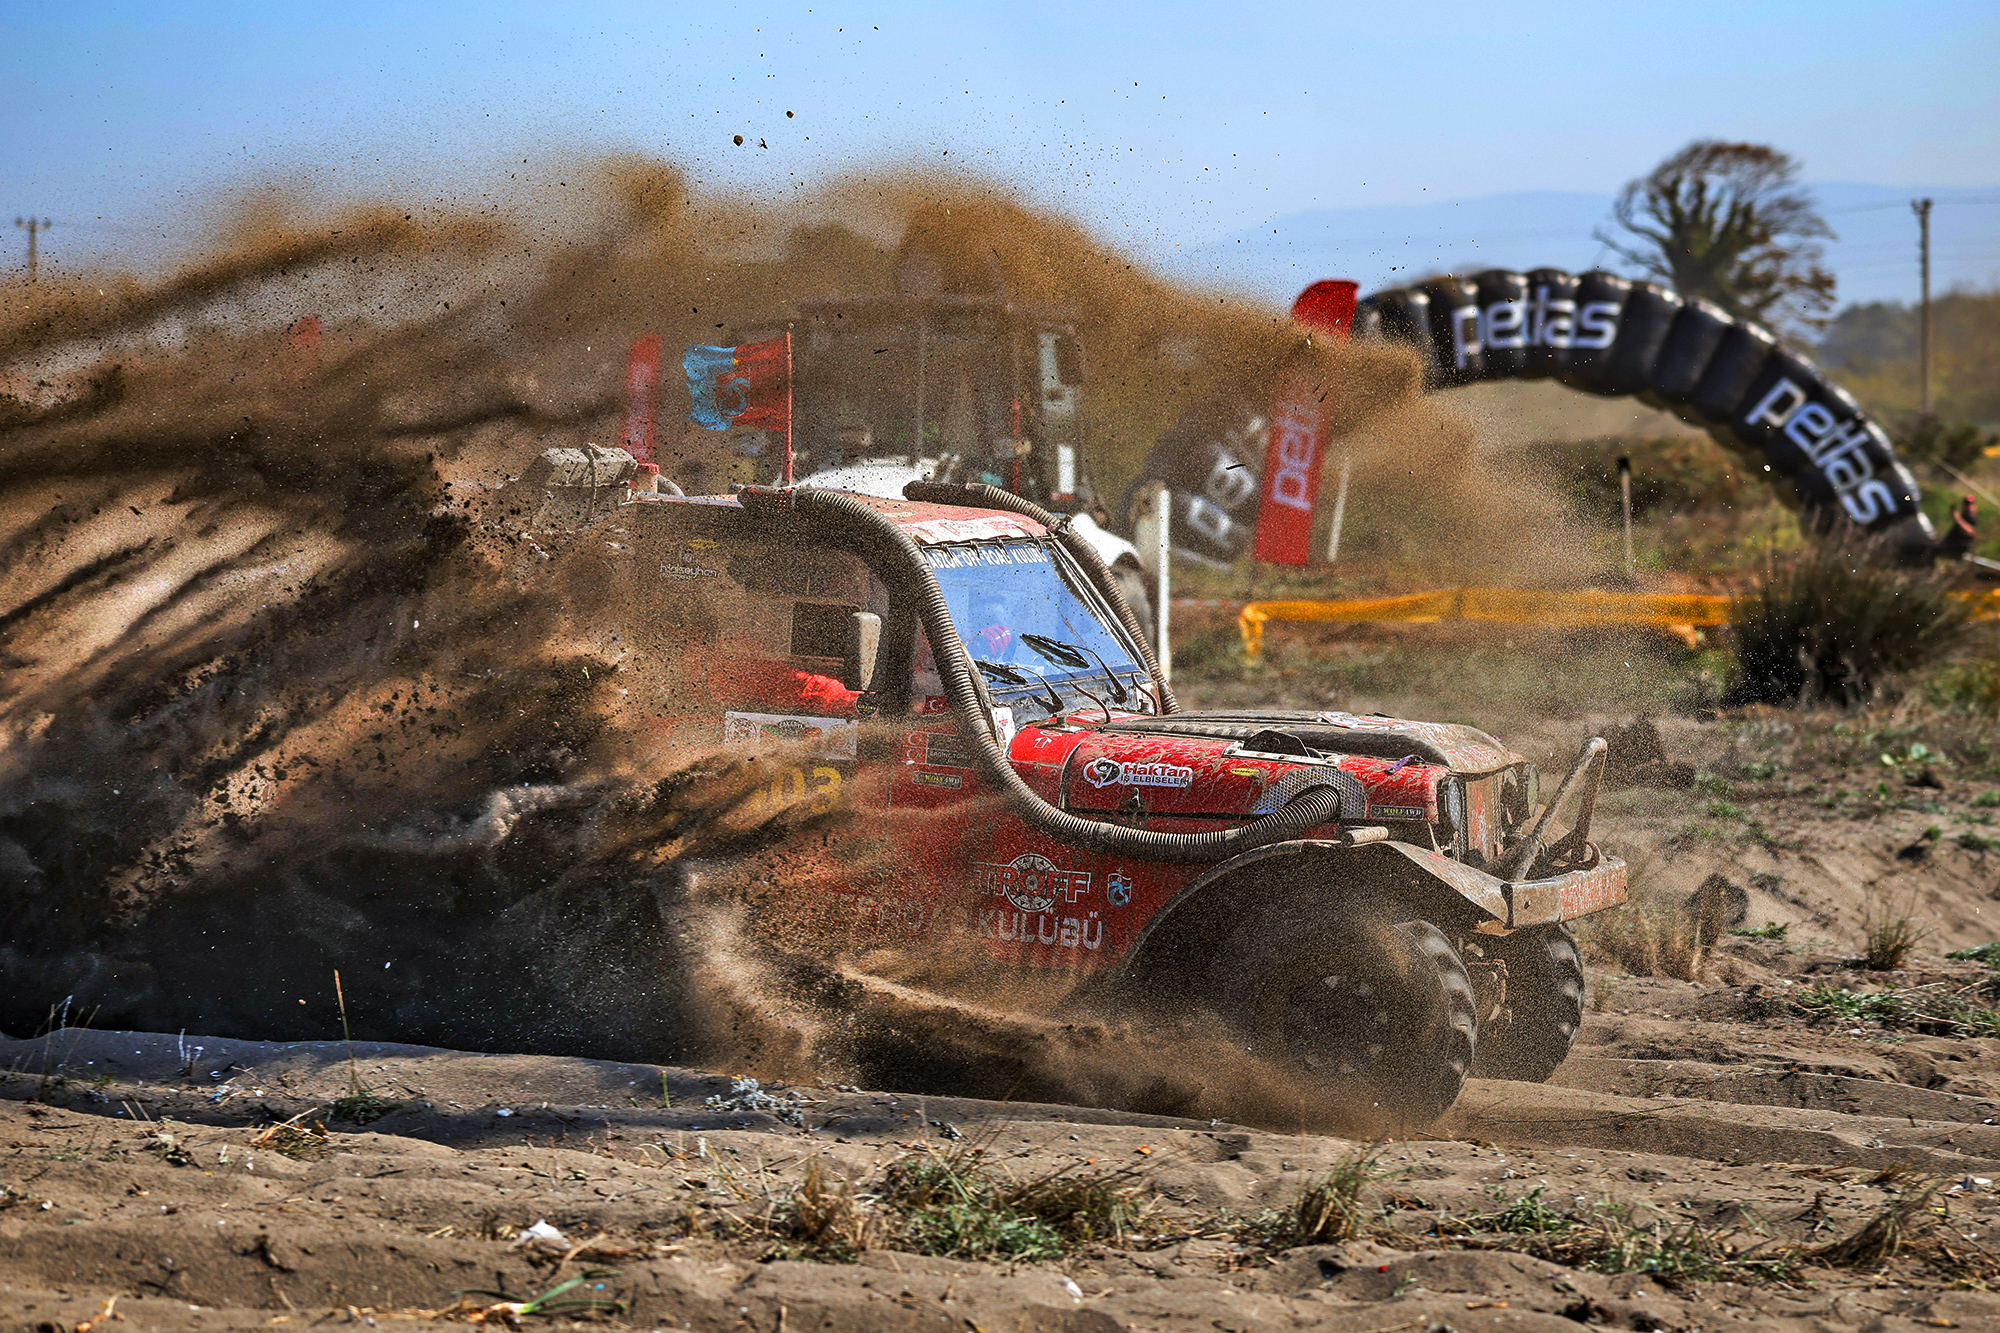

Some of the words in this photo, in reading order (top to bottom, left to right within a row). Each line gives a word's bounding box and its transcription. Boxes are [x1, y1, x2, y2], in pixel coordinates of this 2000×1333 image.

[1452, 286, 1622, 369] petlas
[1745, 377, 1897, 525] petlas
[1123, 764, 1190, 777] HakTan
[973, 858, 1092, 906] TROFF
[976, 907, 1102, 950] KULÜBÜ
